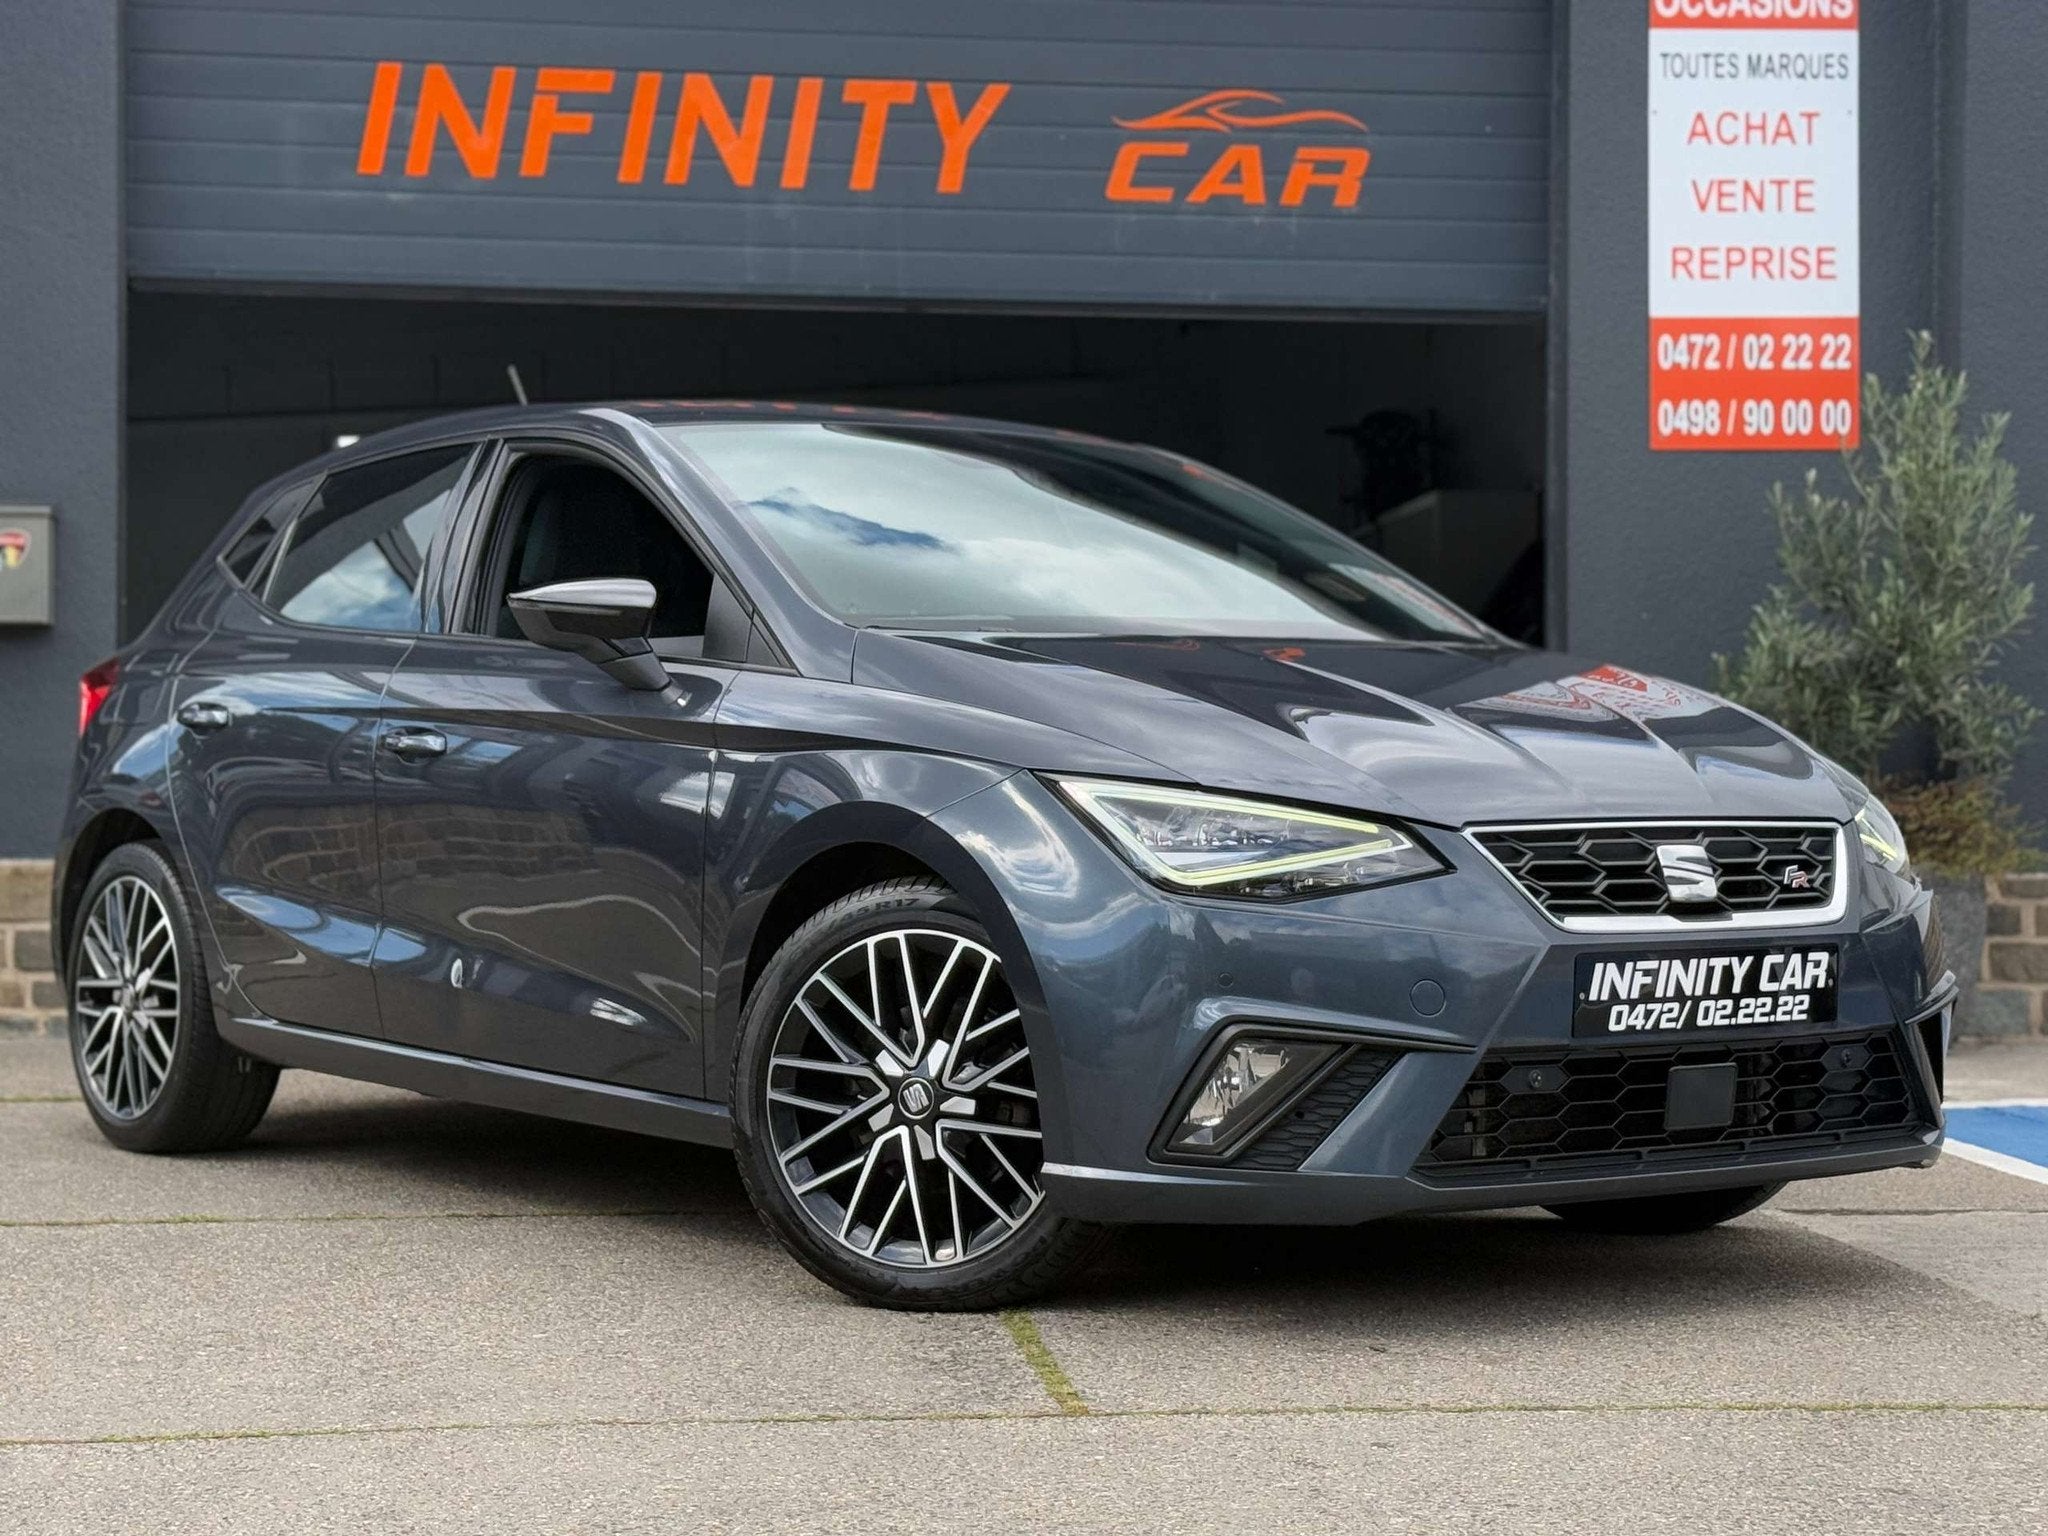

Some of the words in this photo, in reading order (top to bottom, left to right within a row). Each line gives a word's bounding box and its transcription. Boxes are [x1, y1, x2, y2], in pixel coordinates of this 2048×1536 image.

[1655, 0, 1854, 19] OCCASIONS
[1660, 52, 1738, 79] TOUTES
[1747, 53, 1848, 79] MARQUES
[357, 61, 1010, 194] INFINITY
[1106, 142, 1370, 208] CAR
[1687, 111, 1820, 146] ACHAT
[1692, 179, 1815, 213] VENTE
[1671, 246, 1837, 280] REPRISE
[1657, 333, 1721, 370] 0472
[1742, 333, 1775, 370] 02
[1781, 333, 1814, 370] 22
[1820, 333, 1852, 370] 22
[1657, 399, 1721, 436] 0498
[1742, 399, 1775, 436] 90
[1781, 399, 1814, 436] 00
[1820, 399, 1852, 436] 00
[1588, 955, 1754, 1001] INFINITY
[1759, 951, 1830, 992] CAR
[1608, 1000, 1692, 1032] 0472/
[1696, 994, 1811, 1027] 02.22.22
